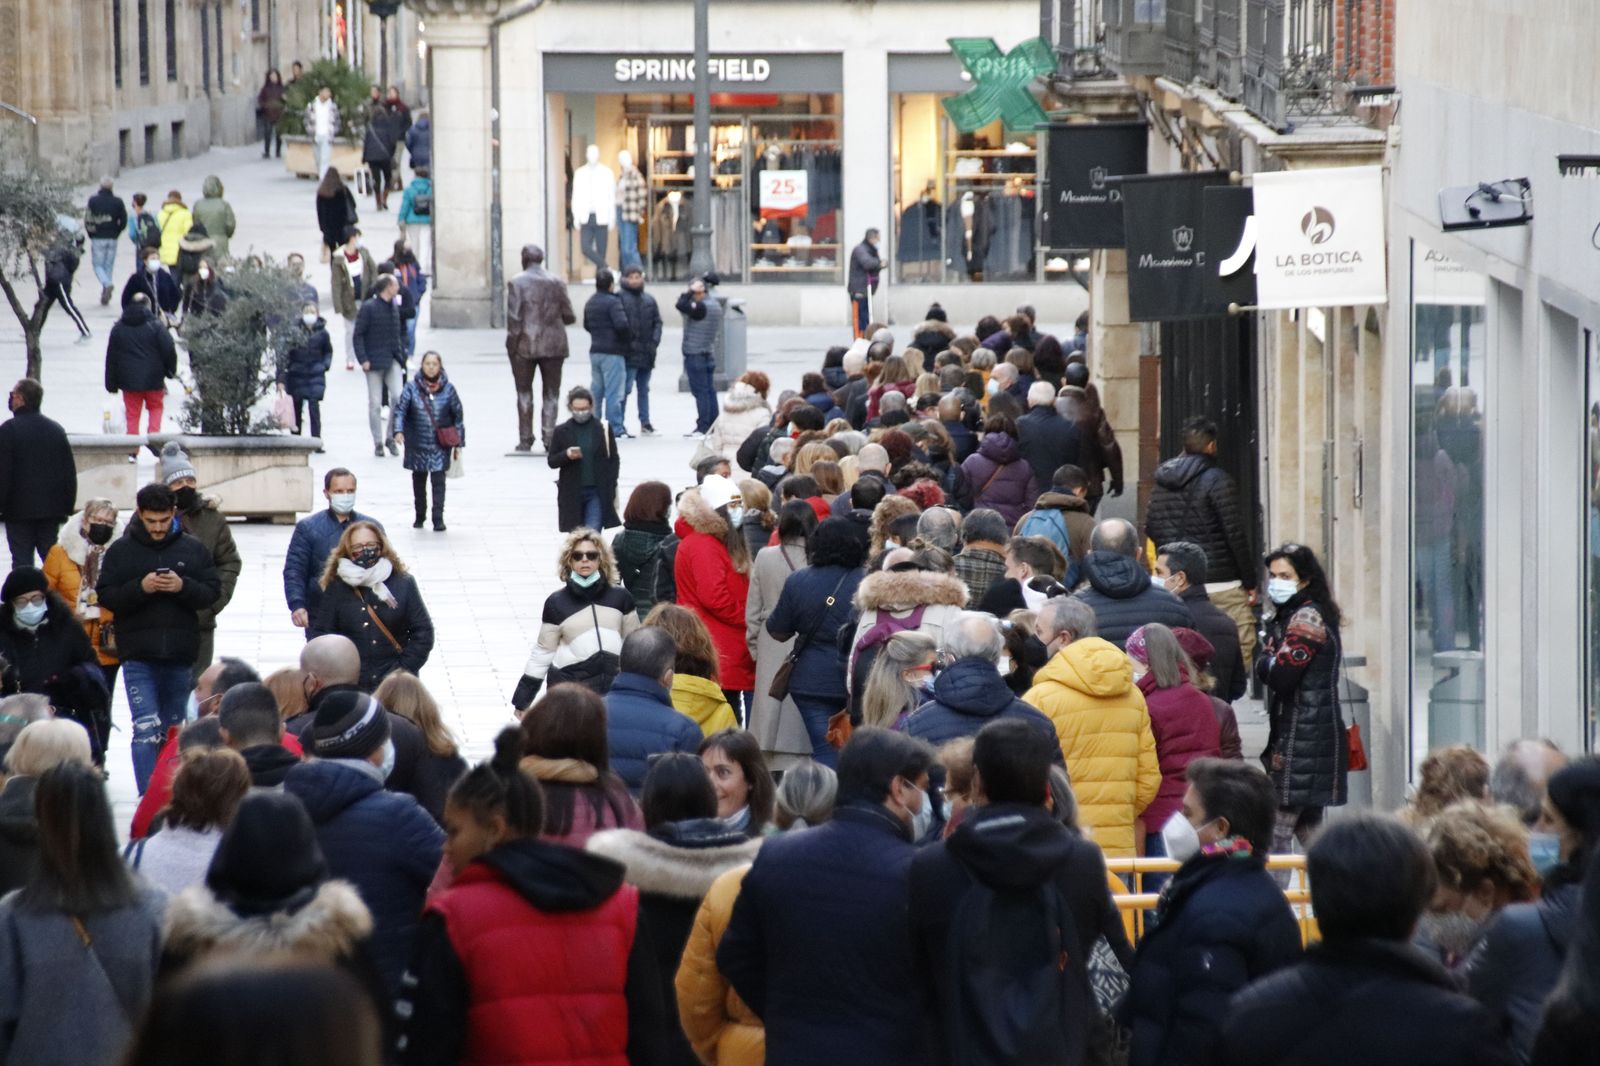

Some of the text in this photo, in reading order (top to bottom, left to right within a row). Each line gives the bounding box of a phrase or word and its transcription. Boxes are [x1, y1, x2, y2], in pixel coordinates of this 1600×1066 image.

[771, 179, 796, 195] 25
[1139, 253, 1193, 268] Massimo
[1275, 250, 1363, 267] LA BOTICA
